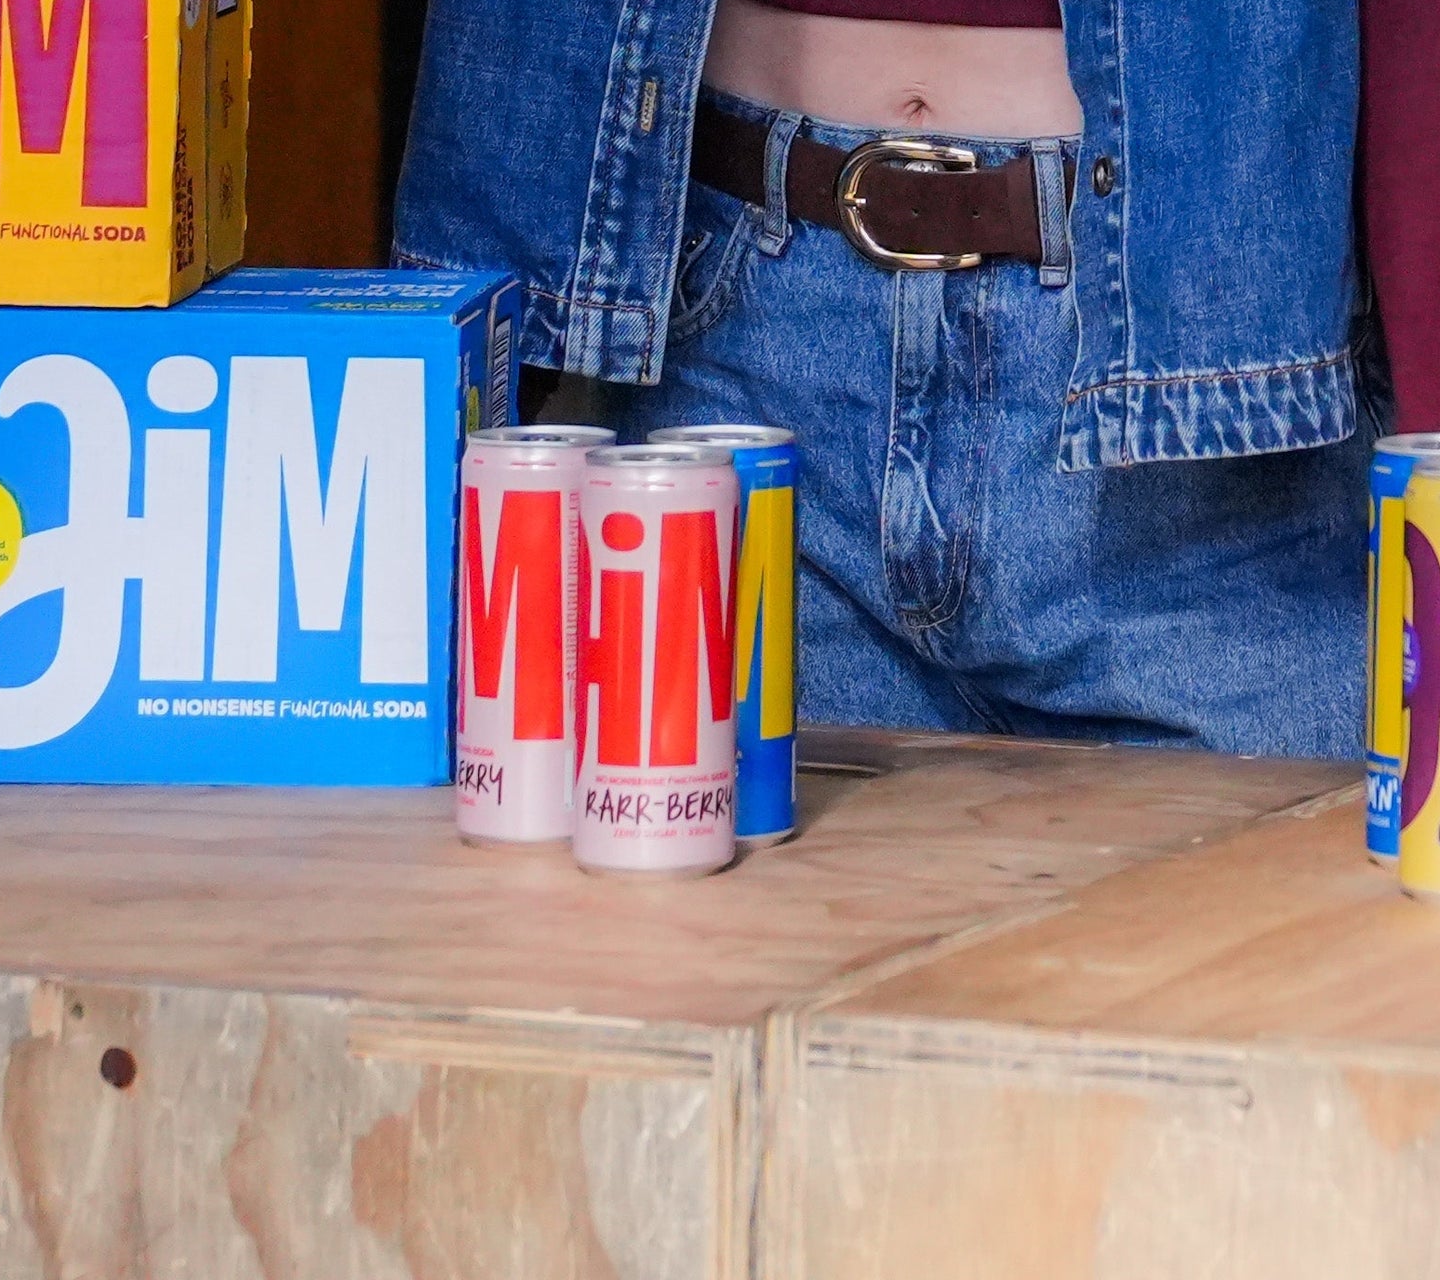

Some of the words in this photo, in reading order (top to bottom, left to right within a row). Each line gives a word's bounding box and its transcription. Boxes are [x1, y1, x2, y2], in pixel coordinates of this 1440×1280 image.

[0, 222, 90, 242] FUNCTIONAL
[93, 226, 146, 242] SODA
[138, 698, 169, 716] NO
[173, 699, 275, 717] NONSENSE
[280, 699, 371, 720] FUNCTIONAL
[373, 701, 427, 719] SODA
[458, 760, 503, 805] ERRY
[584, 787, 733, 825] RARR-BERRY
